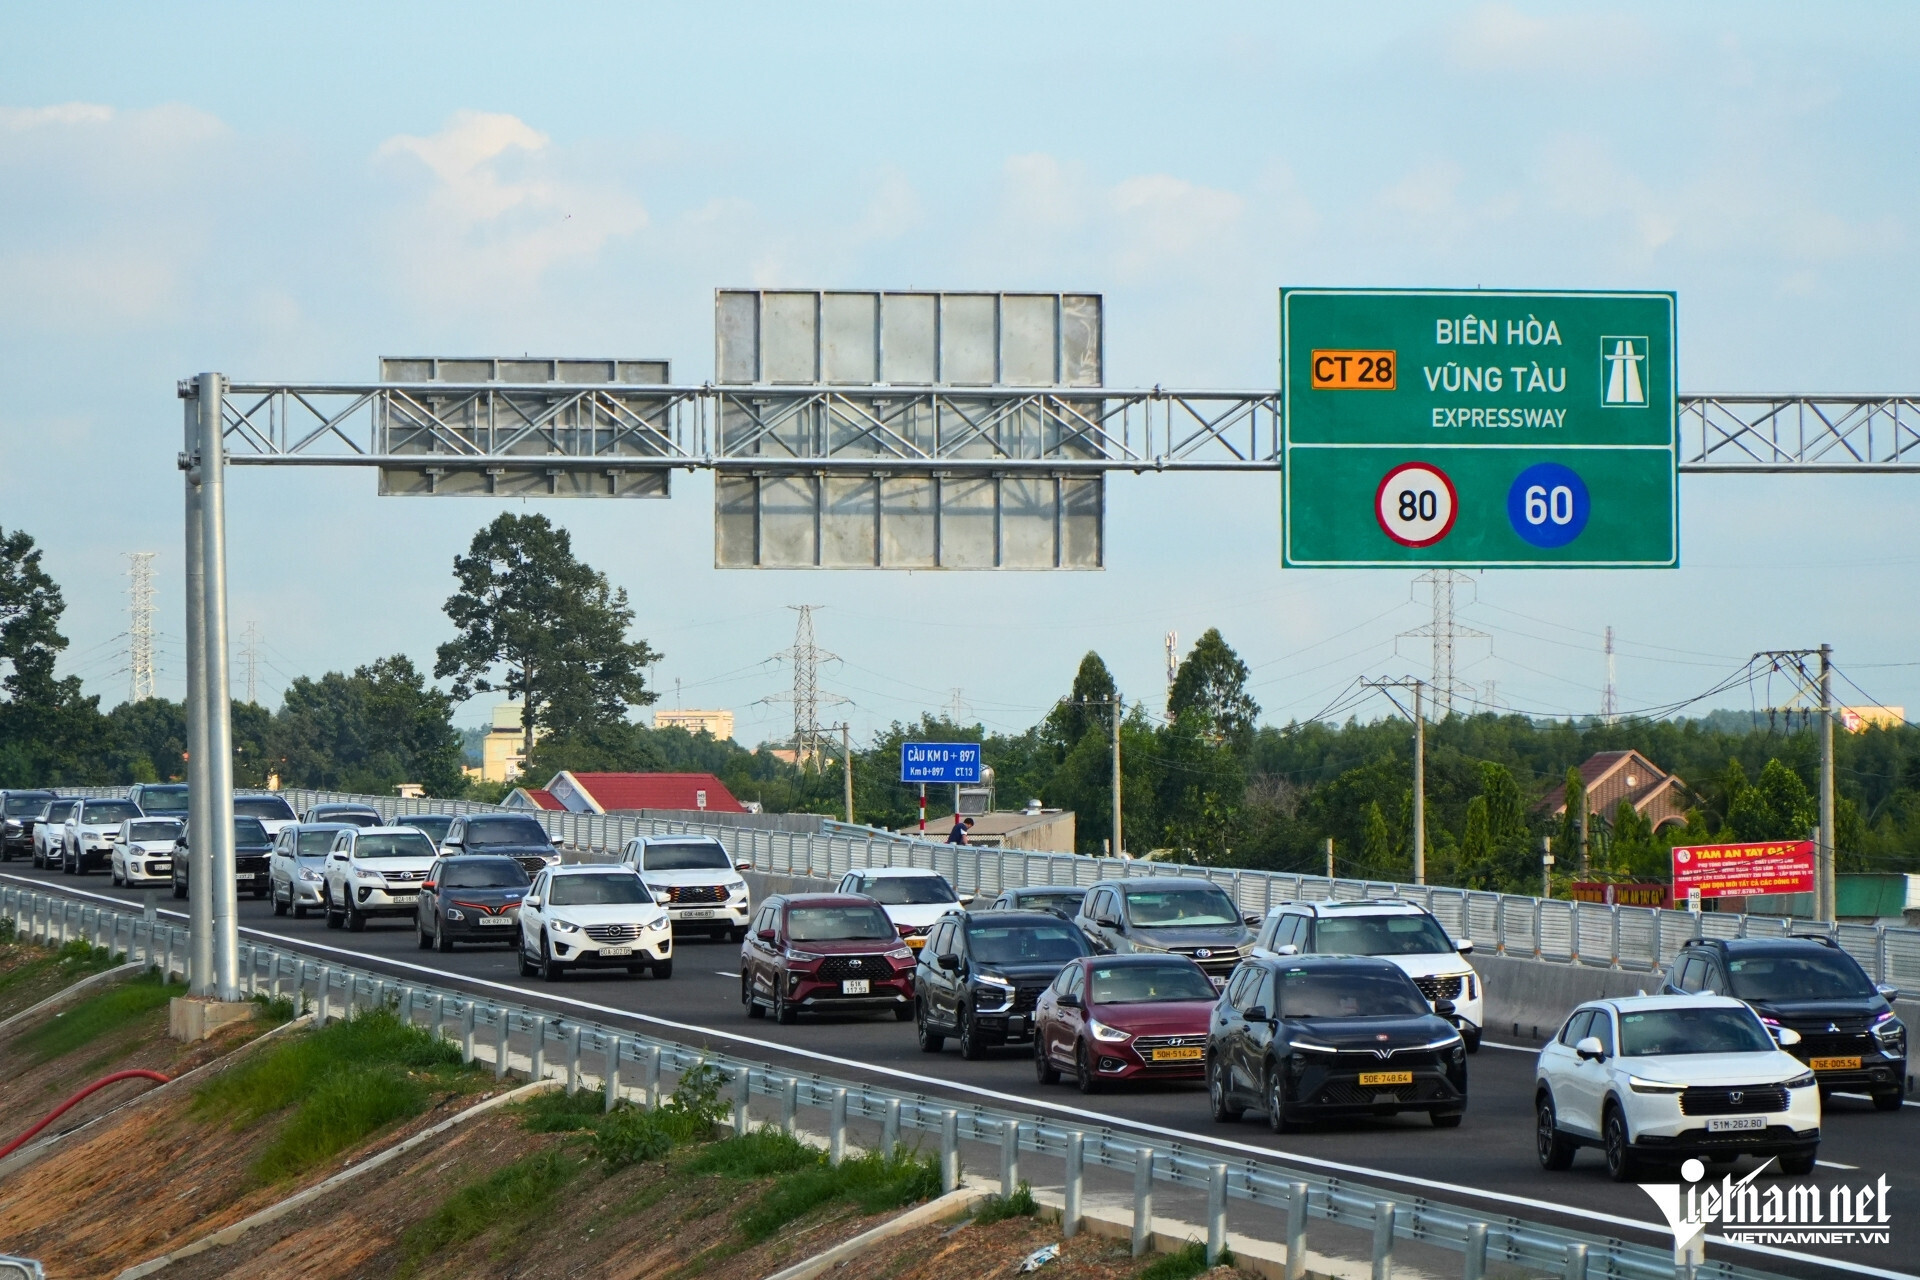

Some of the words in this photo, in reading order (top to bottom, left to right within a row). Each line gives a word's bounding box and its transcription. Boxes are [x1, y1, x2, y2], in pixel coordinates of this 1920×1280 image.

[1436, 313, 1497, 345] BIÊN
[1507, 313, 1562, 345] HÒA
[1314, 357, 1352, 383] CT
[1358, 357, 1393, 383] 28
[1424, 362, 1502, 392] VŨNG
[1511, 361, 1567, 392] TÀU
[1433, 408, 1567, 428] EXPRESSWAY
[1398, 490, 1437, 522] 80
[1525, 485, 1573, 526] 60
[927, 750, 941, 761] KM
[943, 750, 949, 762] 0
[960, 750, 975, 762] 897
[910, 767, 921, 776] Km
[1724, 849, 1742, 858] AN
[1745, 847, 1764, 857] TAY
[1363, 1074, 1408, 1083] 50E-748.64
[1713, 1119, 1762, 1130] 51M-282.80
